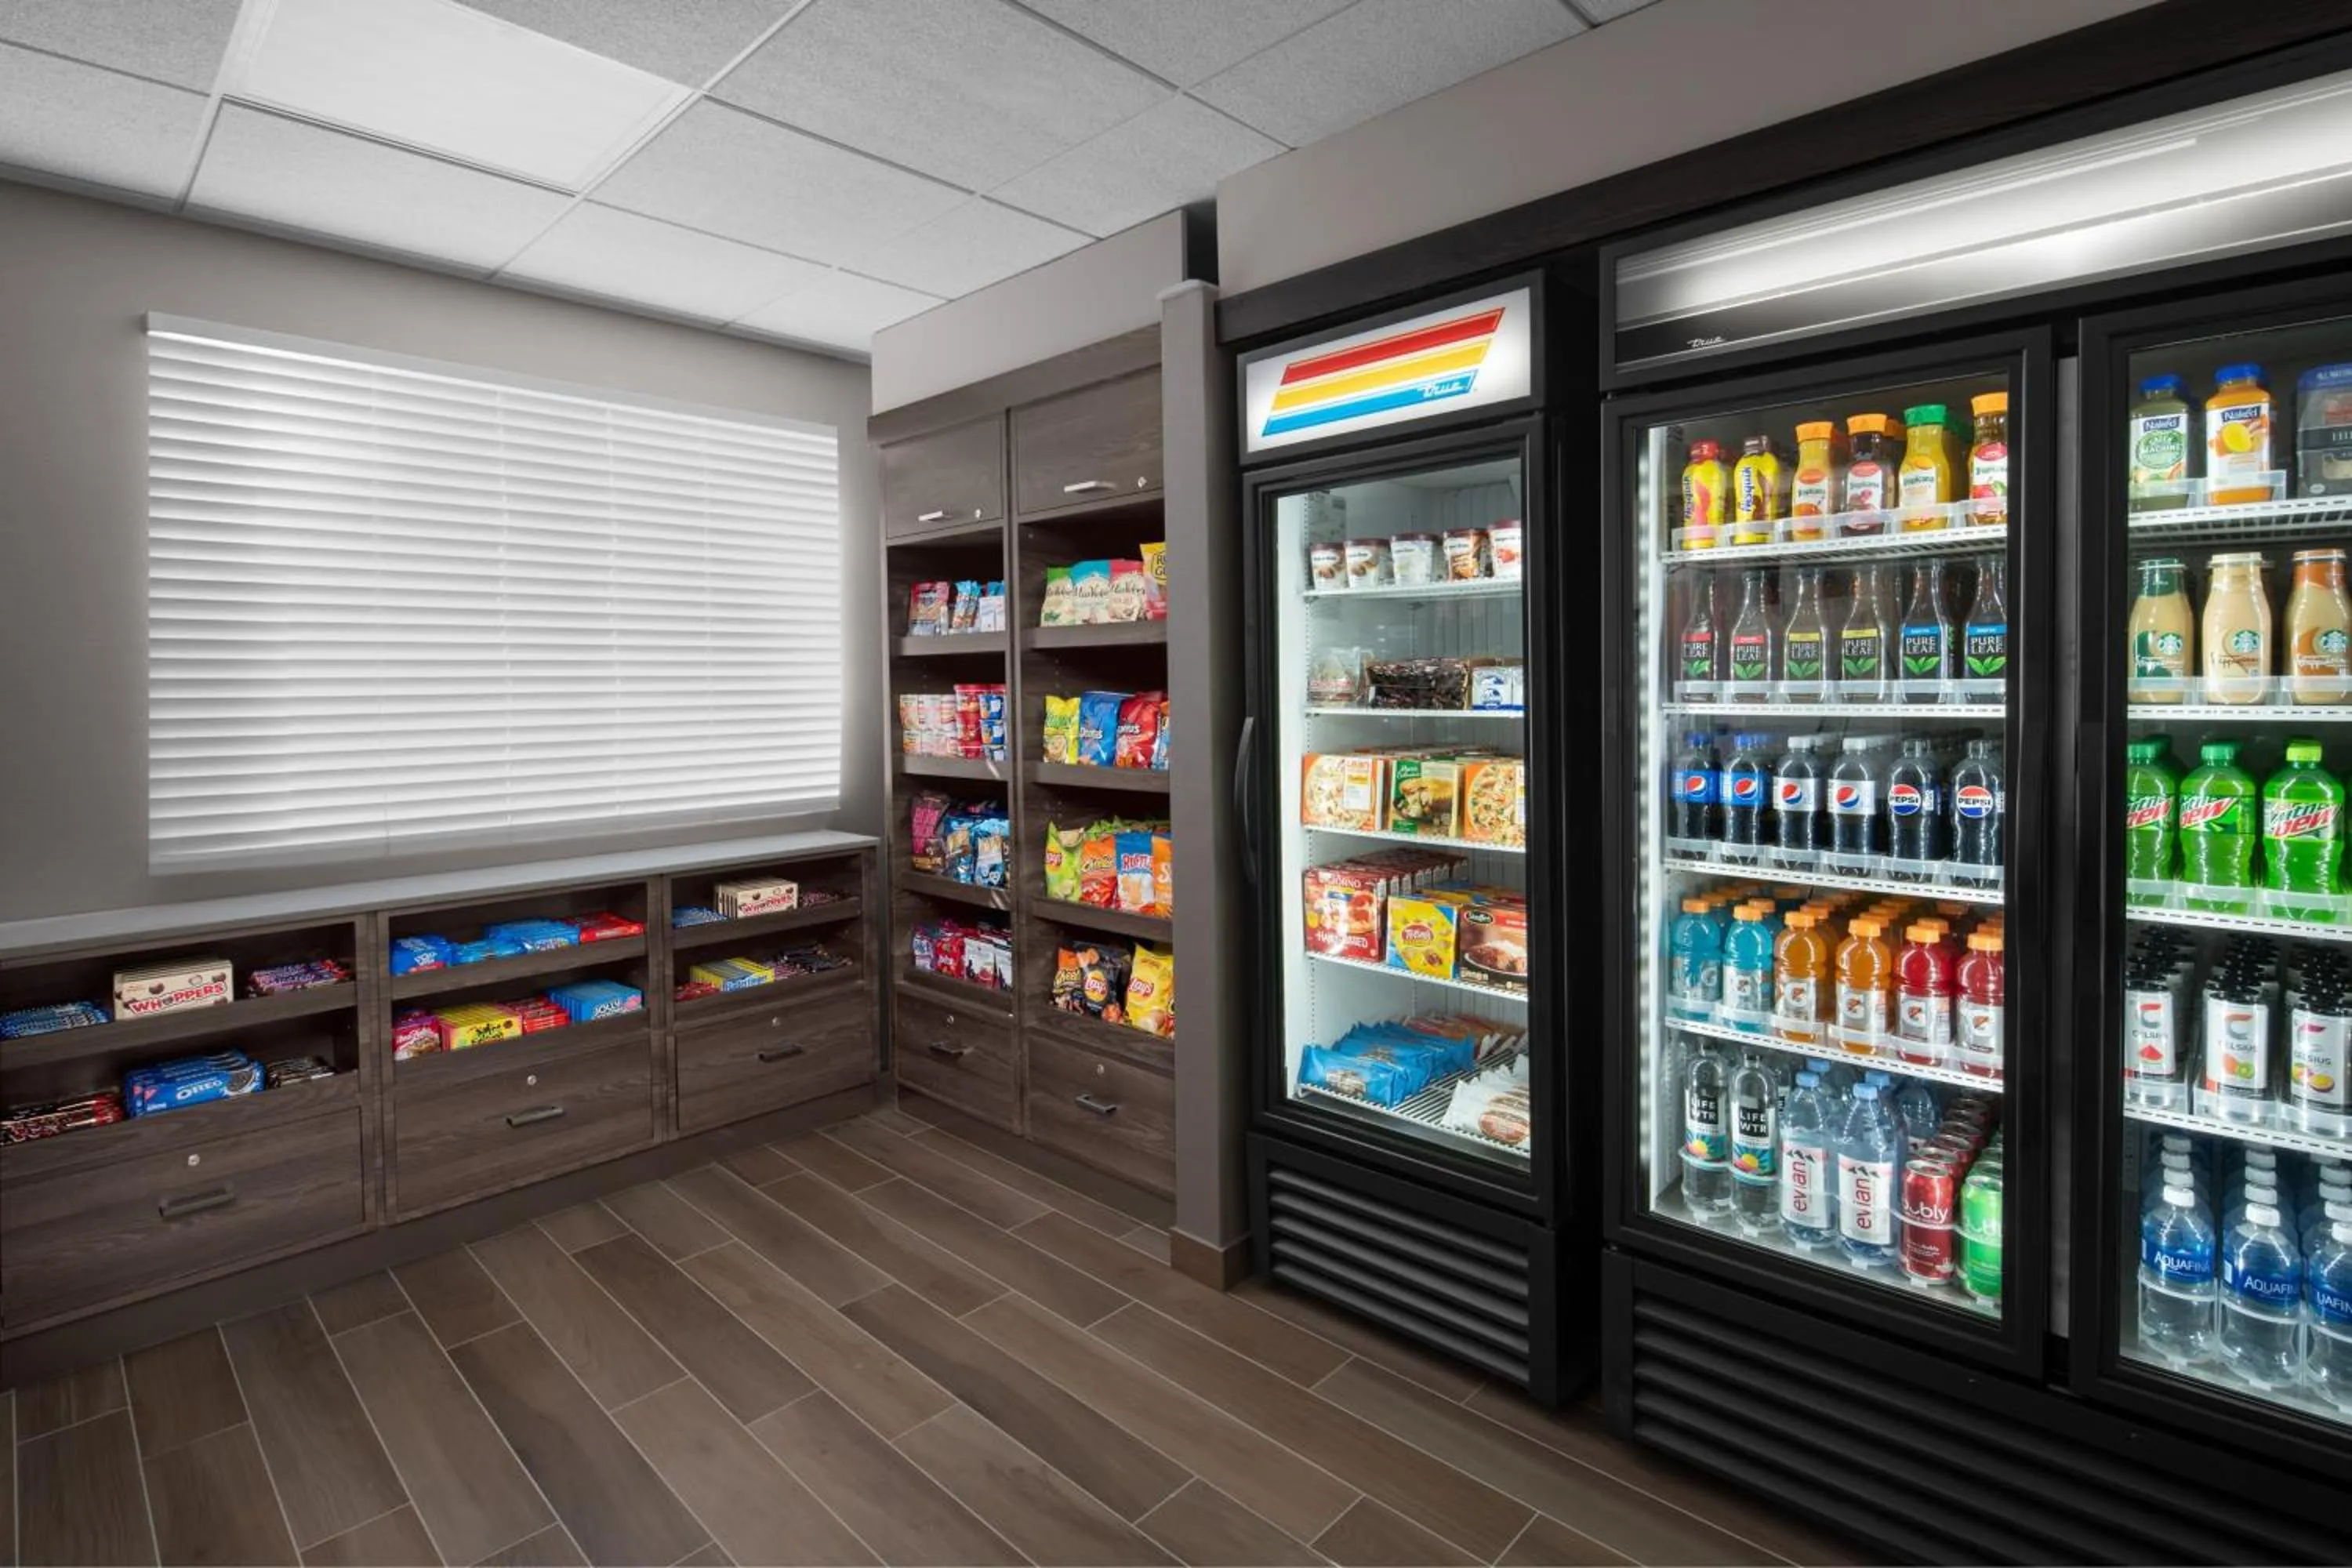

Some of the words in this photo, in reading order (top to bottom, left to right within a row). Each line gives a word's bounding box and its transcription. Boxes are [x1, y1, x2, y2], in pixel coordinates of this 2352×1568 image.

[1906, 636, 1936, 645] PURE
[1971, 636, 2004, 645] PURE
[1906, 645, 1936, 654] LEAF
[1971, 645, 2004, 655] LEAF
[176, 1080, 223, 1101] OREO
[1740, 1109, 1767, 1122] LIFE
[1740, 1120, 1767, 1133] WTR
[1793, 1160, 1807, 1212] evian
[1853, 1178, 1872, 1229] evian
[2154, 1251, 2210, 1273] AQUAFINA
